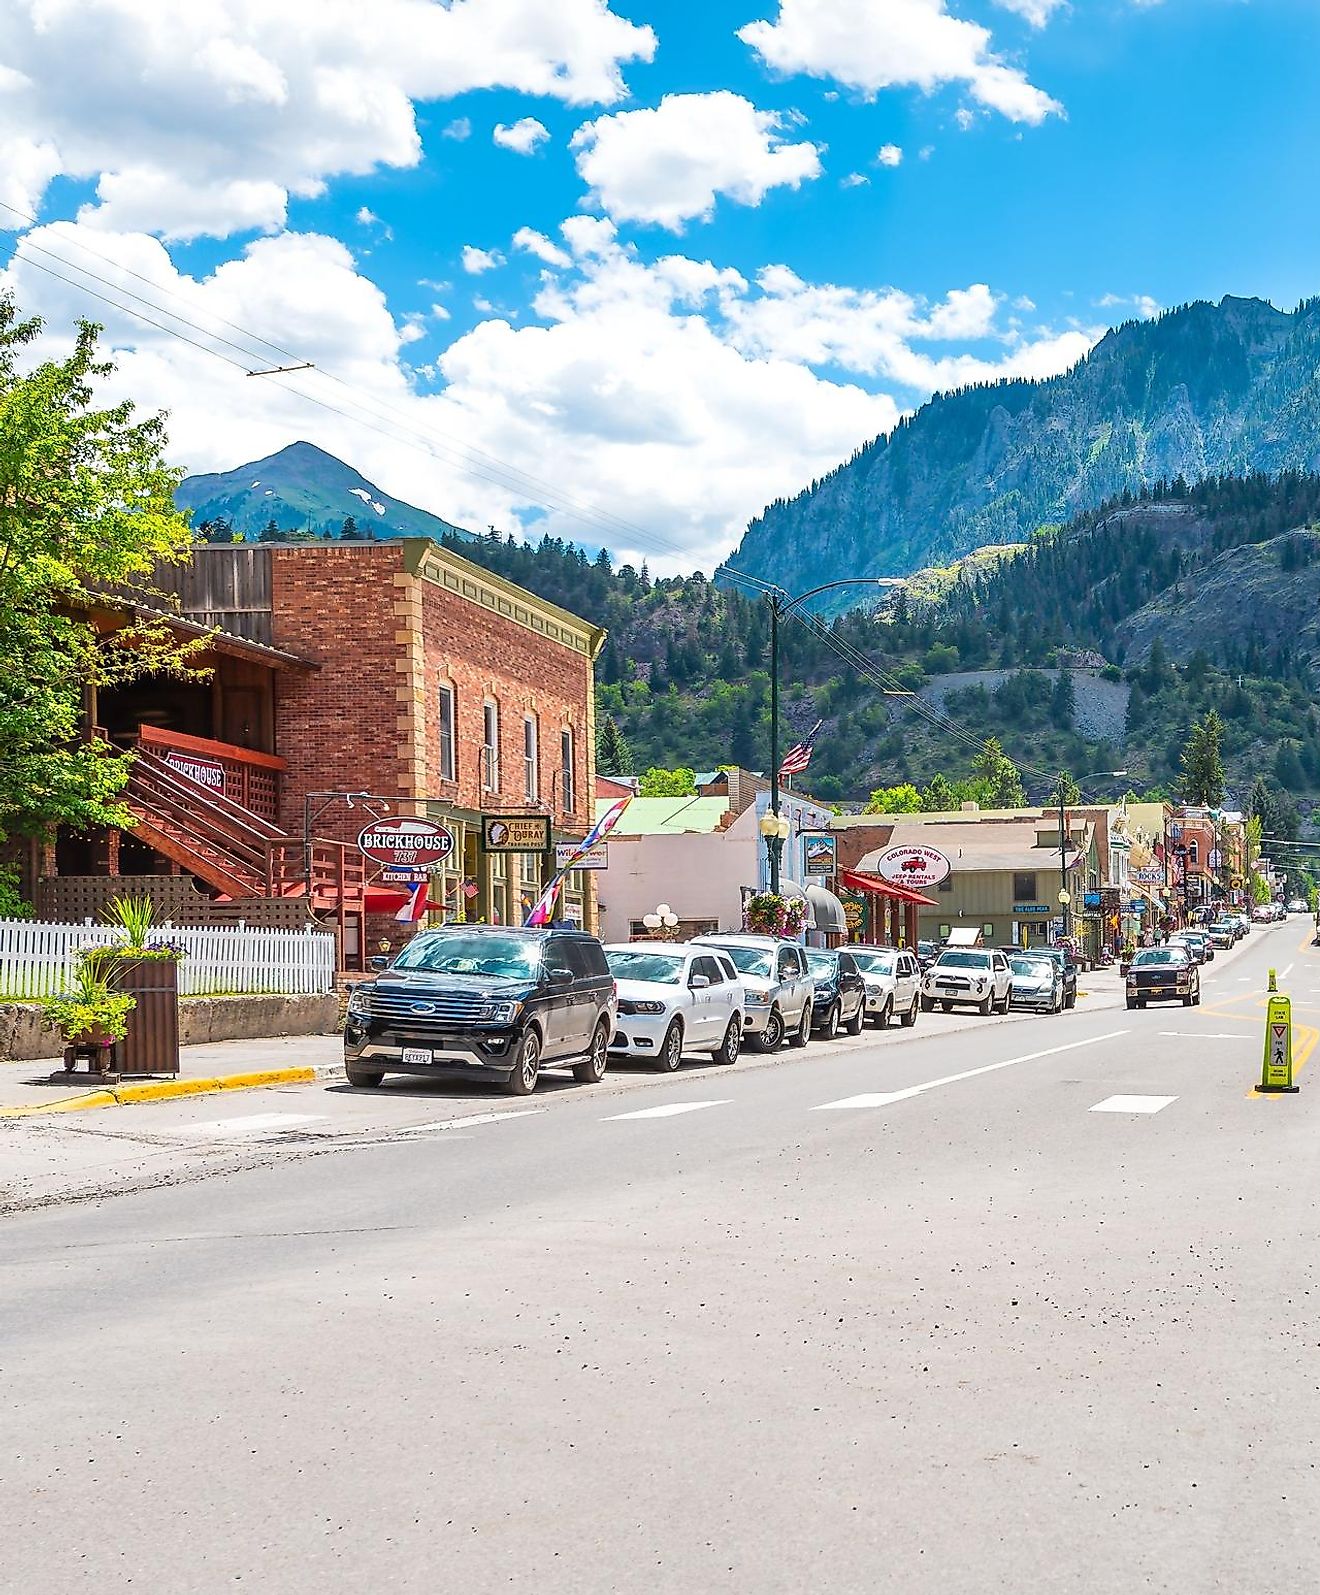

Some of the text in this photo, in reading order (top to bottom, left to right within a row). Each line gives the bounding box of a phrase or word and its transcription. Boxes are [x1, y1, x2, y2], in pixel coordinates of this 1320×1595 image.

[509, 822, 533, 833] CHIEF
[363, 833, 449, 851] BRICKHOUSE
[514, 831, 545, 841] OURAY
[393, 850, 418, 863] 737
[887, 849, 941, 862] COLORADO WEST
[382, 872, 428, 881] KITCHEN BAR
